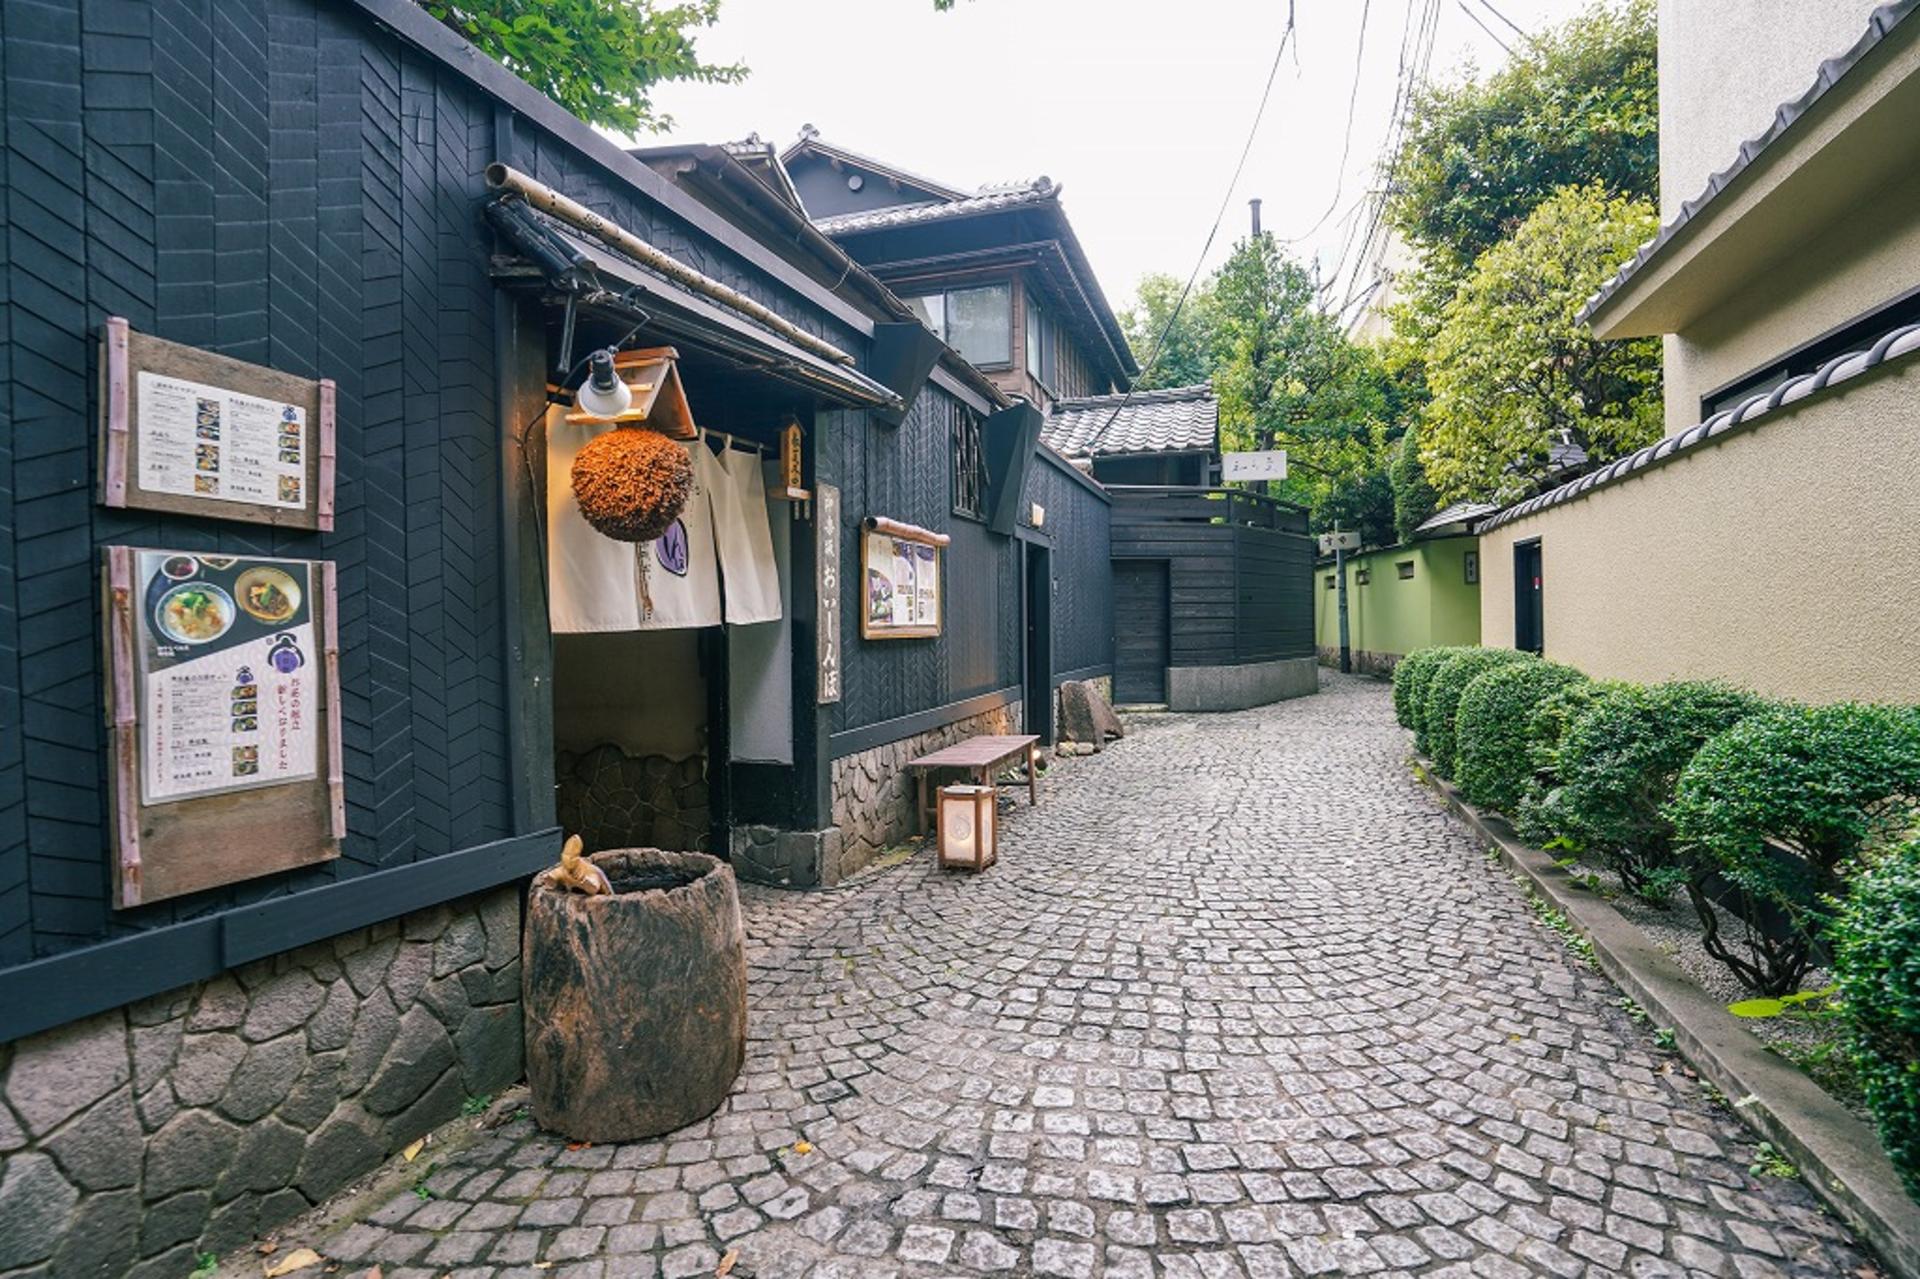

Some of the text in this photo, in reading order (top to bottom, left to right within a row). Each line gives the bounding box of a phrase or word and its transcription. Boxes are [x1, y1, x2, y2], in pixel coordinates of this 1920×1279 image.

[823, 493, 838, 697] おいしんぼ
